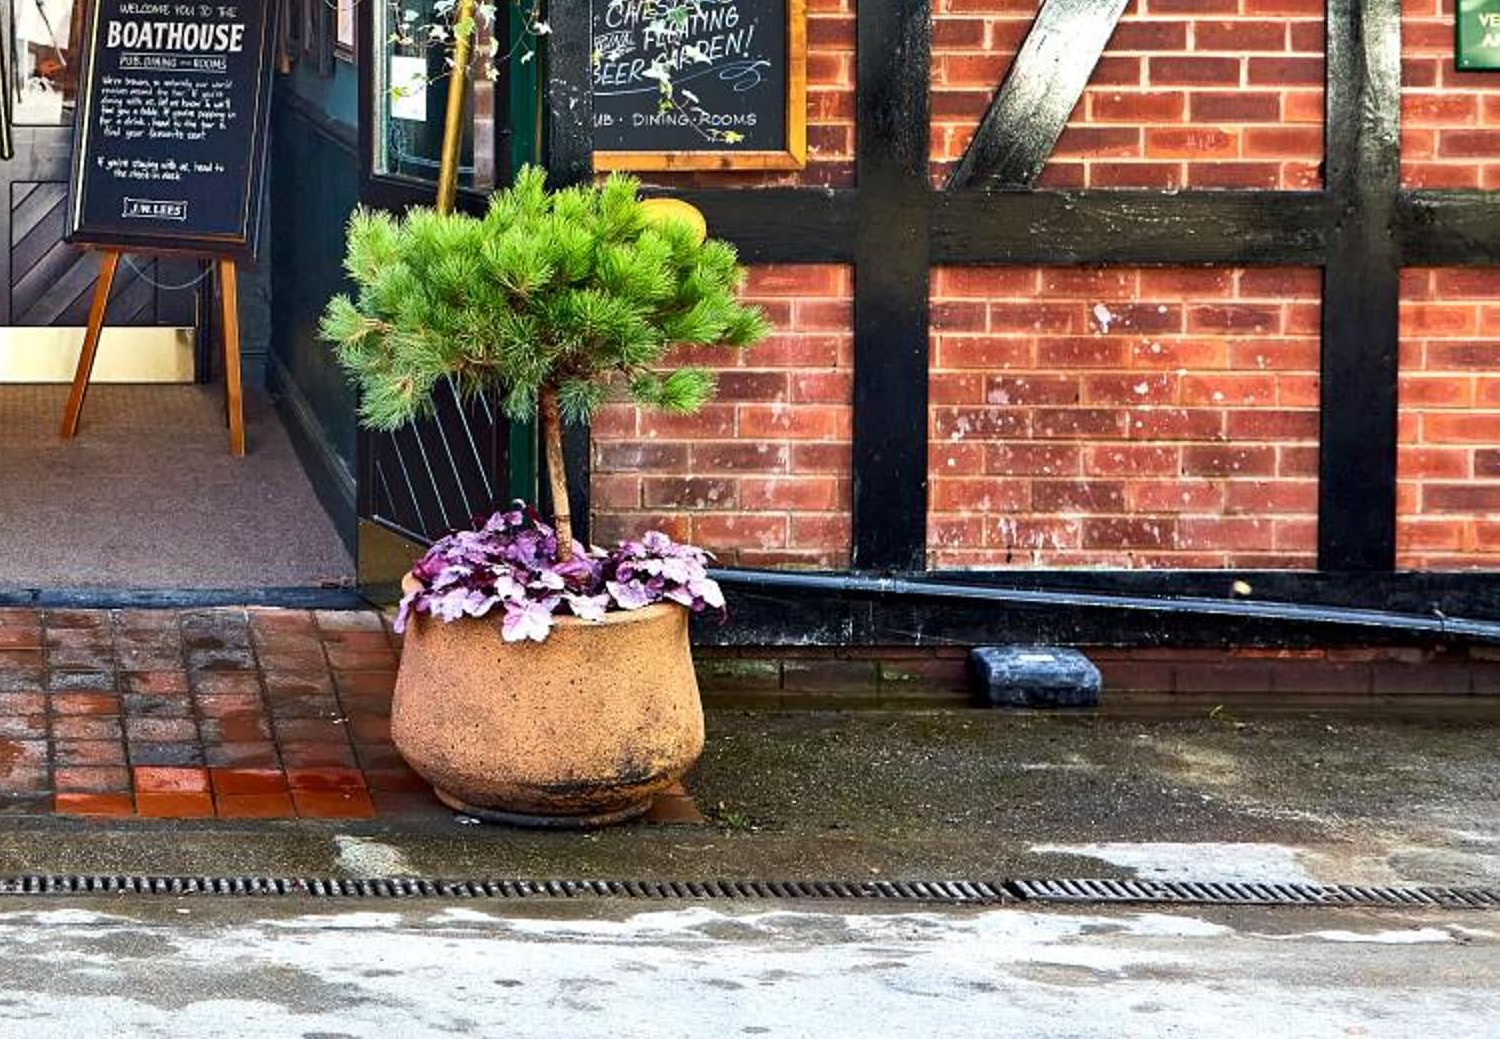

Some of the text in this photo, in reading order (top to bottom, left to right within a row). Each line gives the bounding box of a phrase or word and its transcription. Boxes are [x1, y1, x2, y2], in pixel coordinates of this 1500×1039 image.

[106, 20, 245, 53] BOATHOUSE
[594, 112, 758, 127] UB DINING ROOMS
